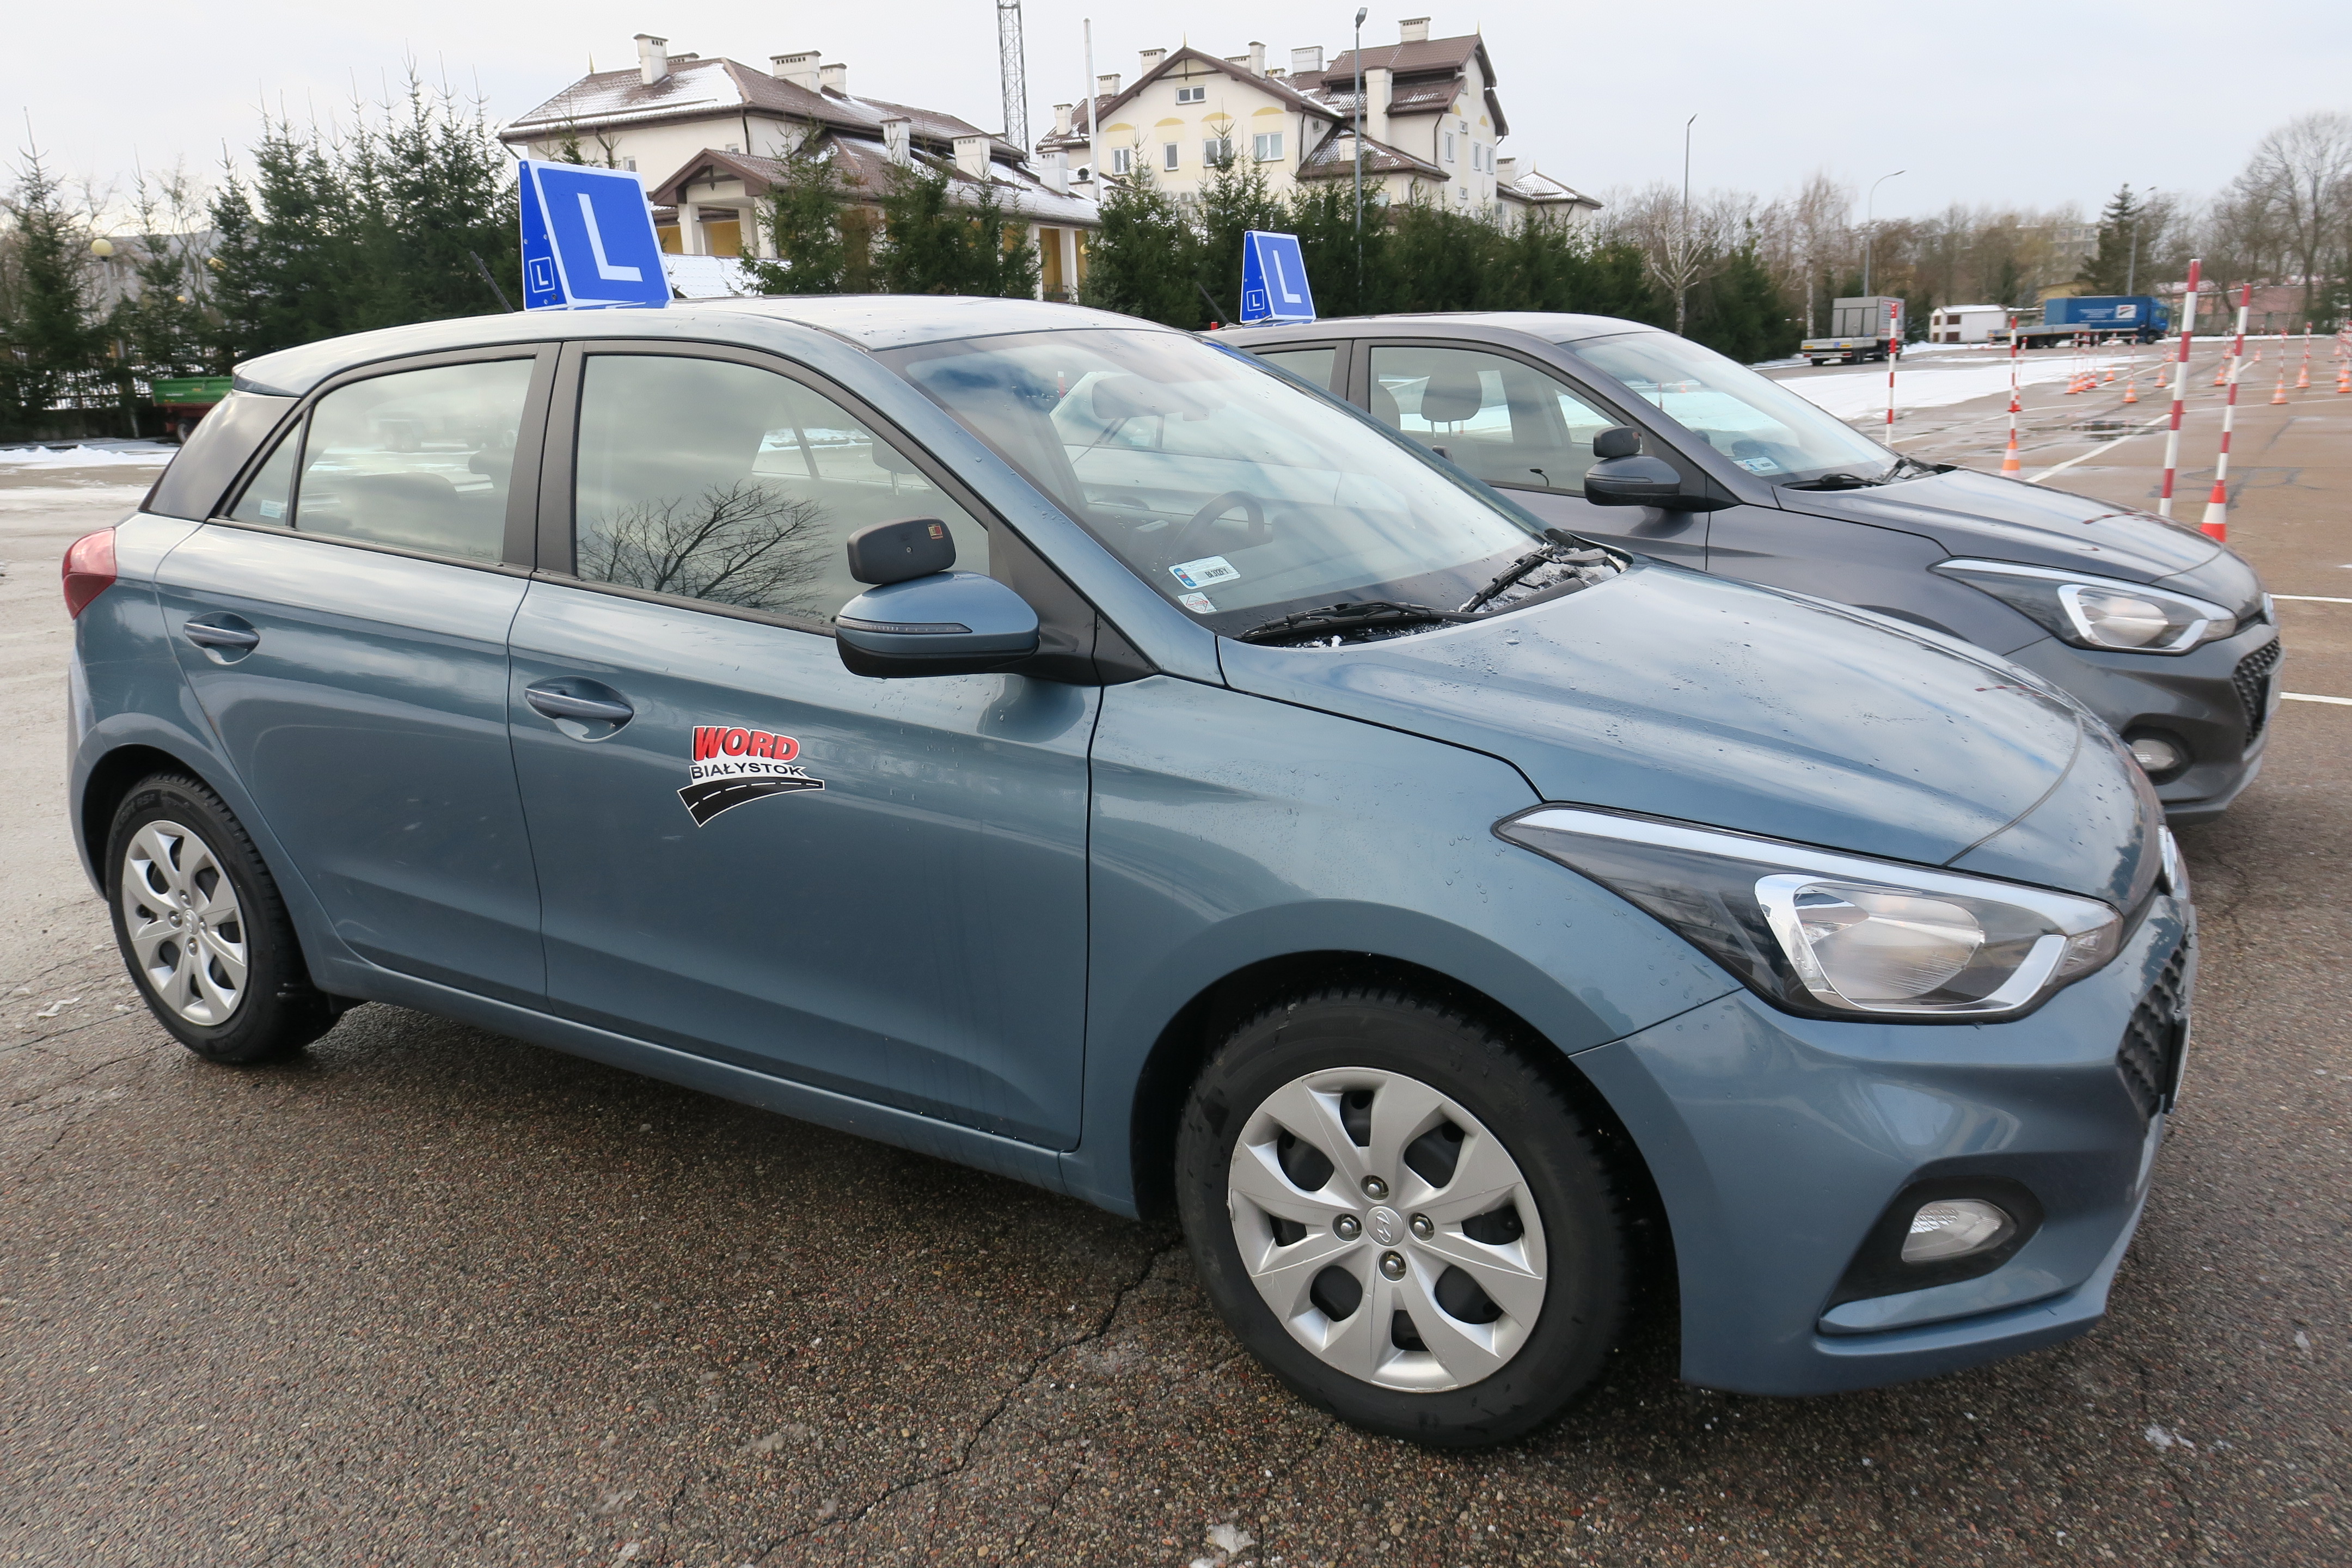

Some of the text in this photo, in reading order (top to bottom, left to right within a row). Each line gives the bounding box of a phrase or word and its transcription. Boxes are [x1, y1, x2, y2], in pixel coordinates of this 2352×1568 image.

[577, 193, 644, 282] L
[537, 265, 549, 286] L
[1272, 250, 1302, 303] L
[1252, 294, 1260, 307] L
[693, 727, 799, 761] WORD
[691, 762, 804, 779] BIAŁYSTOK
